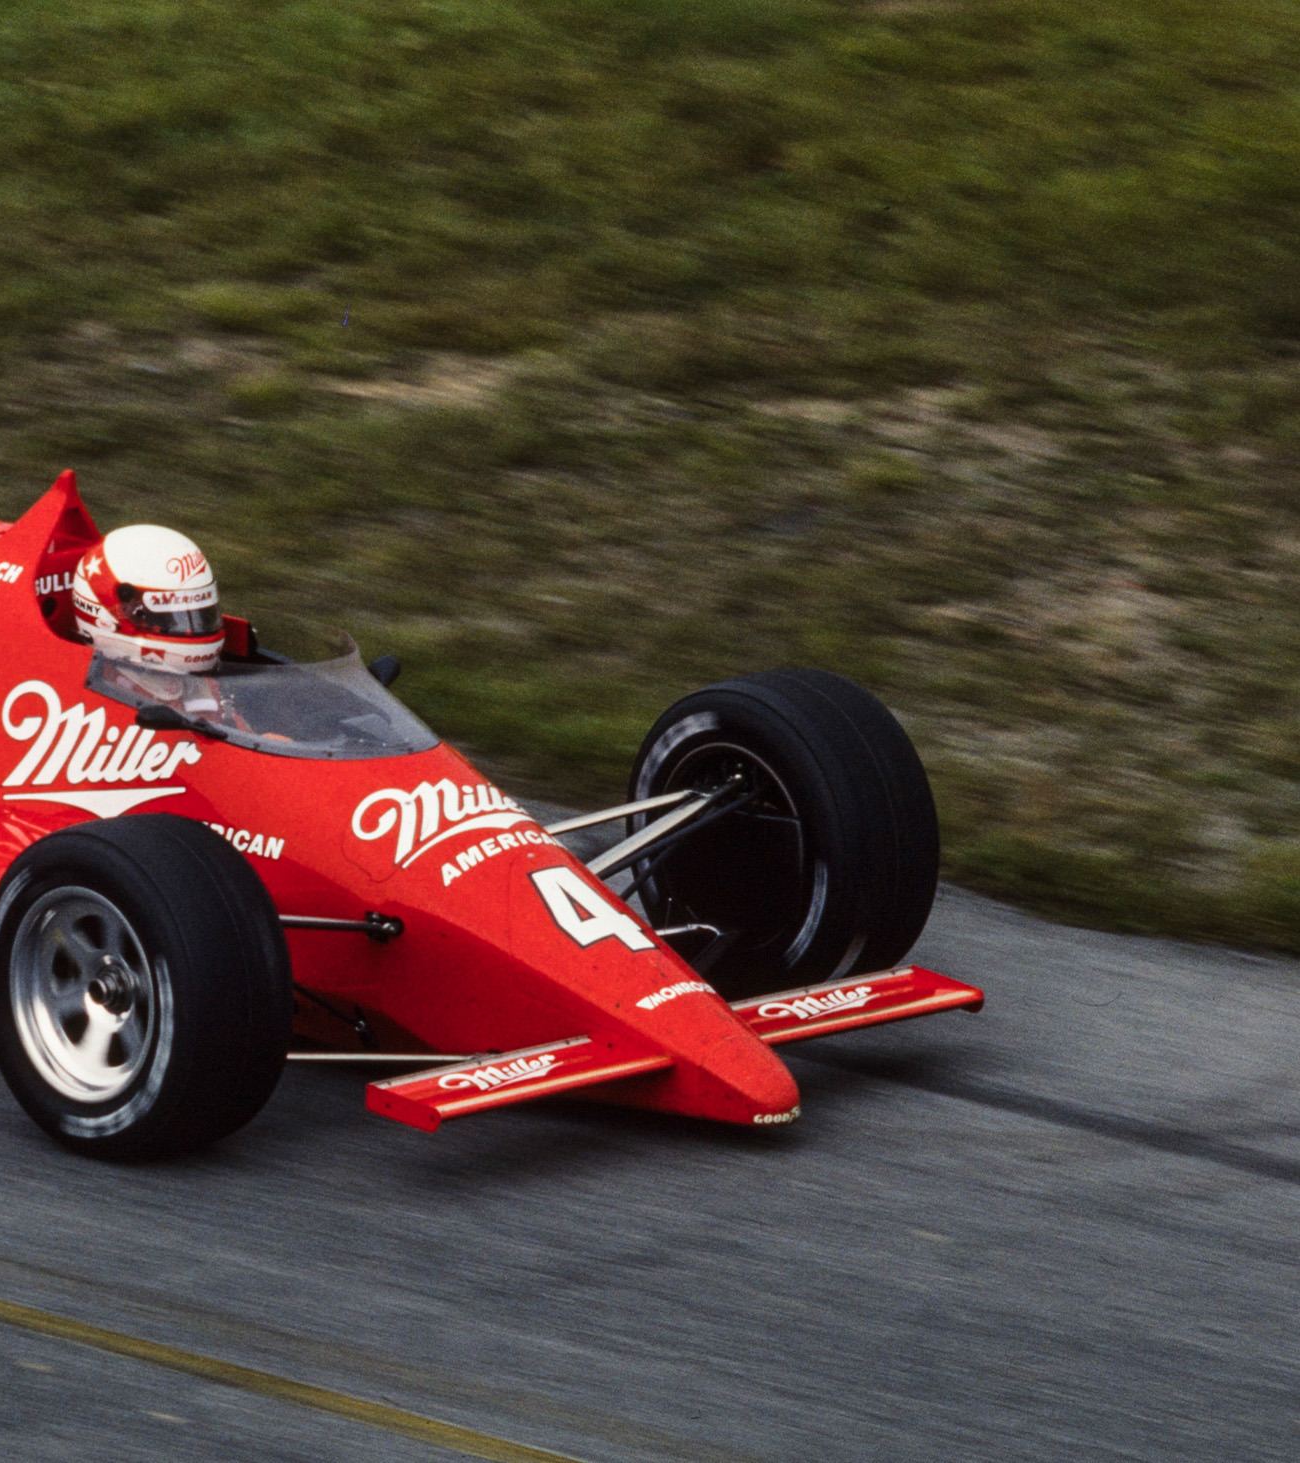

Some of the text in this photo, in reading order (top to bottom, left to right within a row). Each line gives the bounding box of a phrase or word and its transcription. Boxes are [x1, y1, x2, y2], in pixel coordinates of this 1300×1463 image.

[2, 680, 201, 787] Miller
[351, 778, 529, 865] Mille
[527, 864, 661, 952] 4
[758, 986, 872, 1020] Miller
[438, 1054, 555, 1091] Miller
